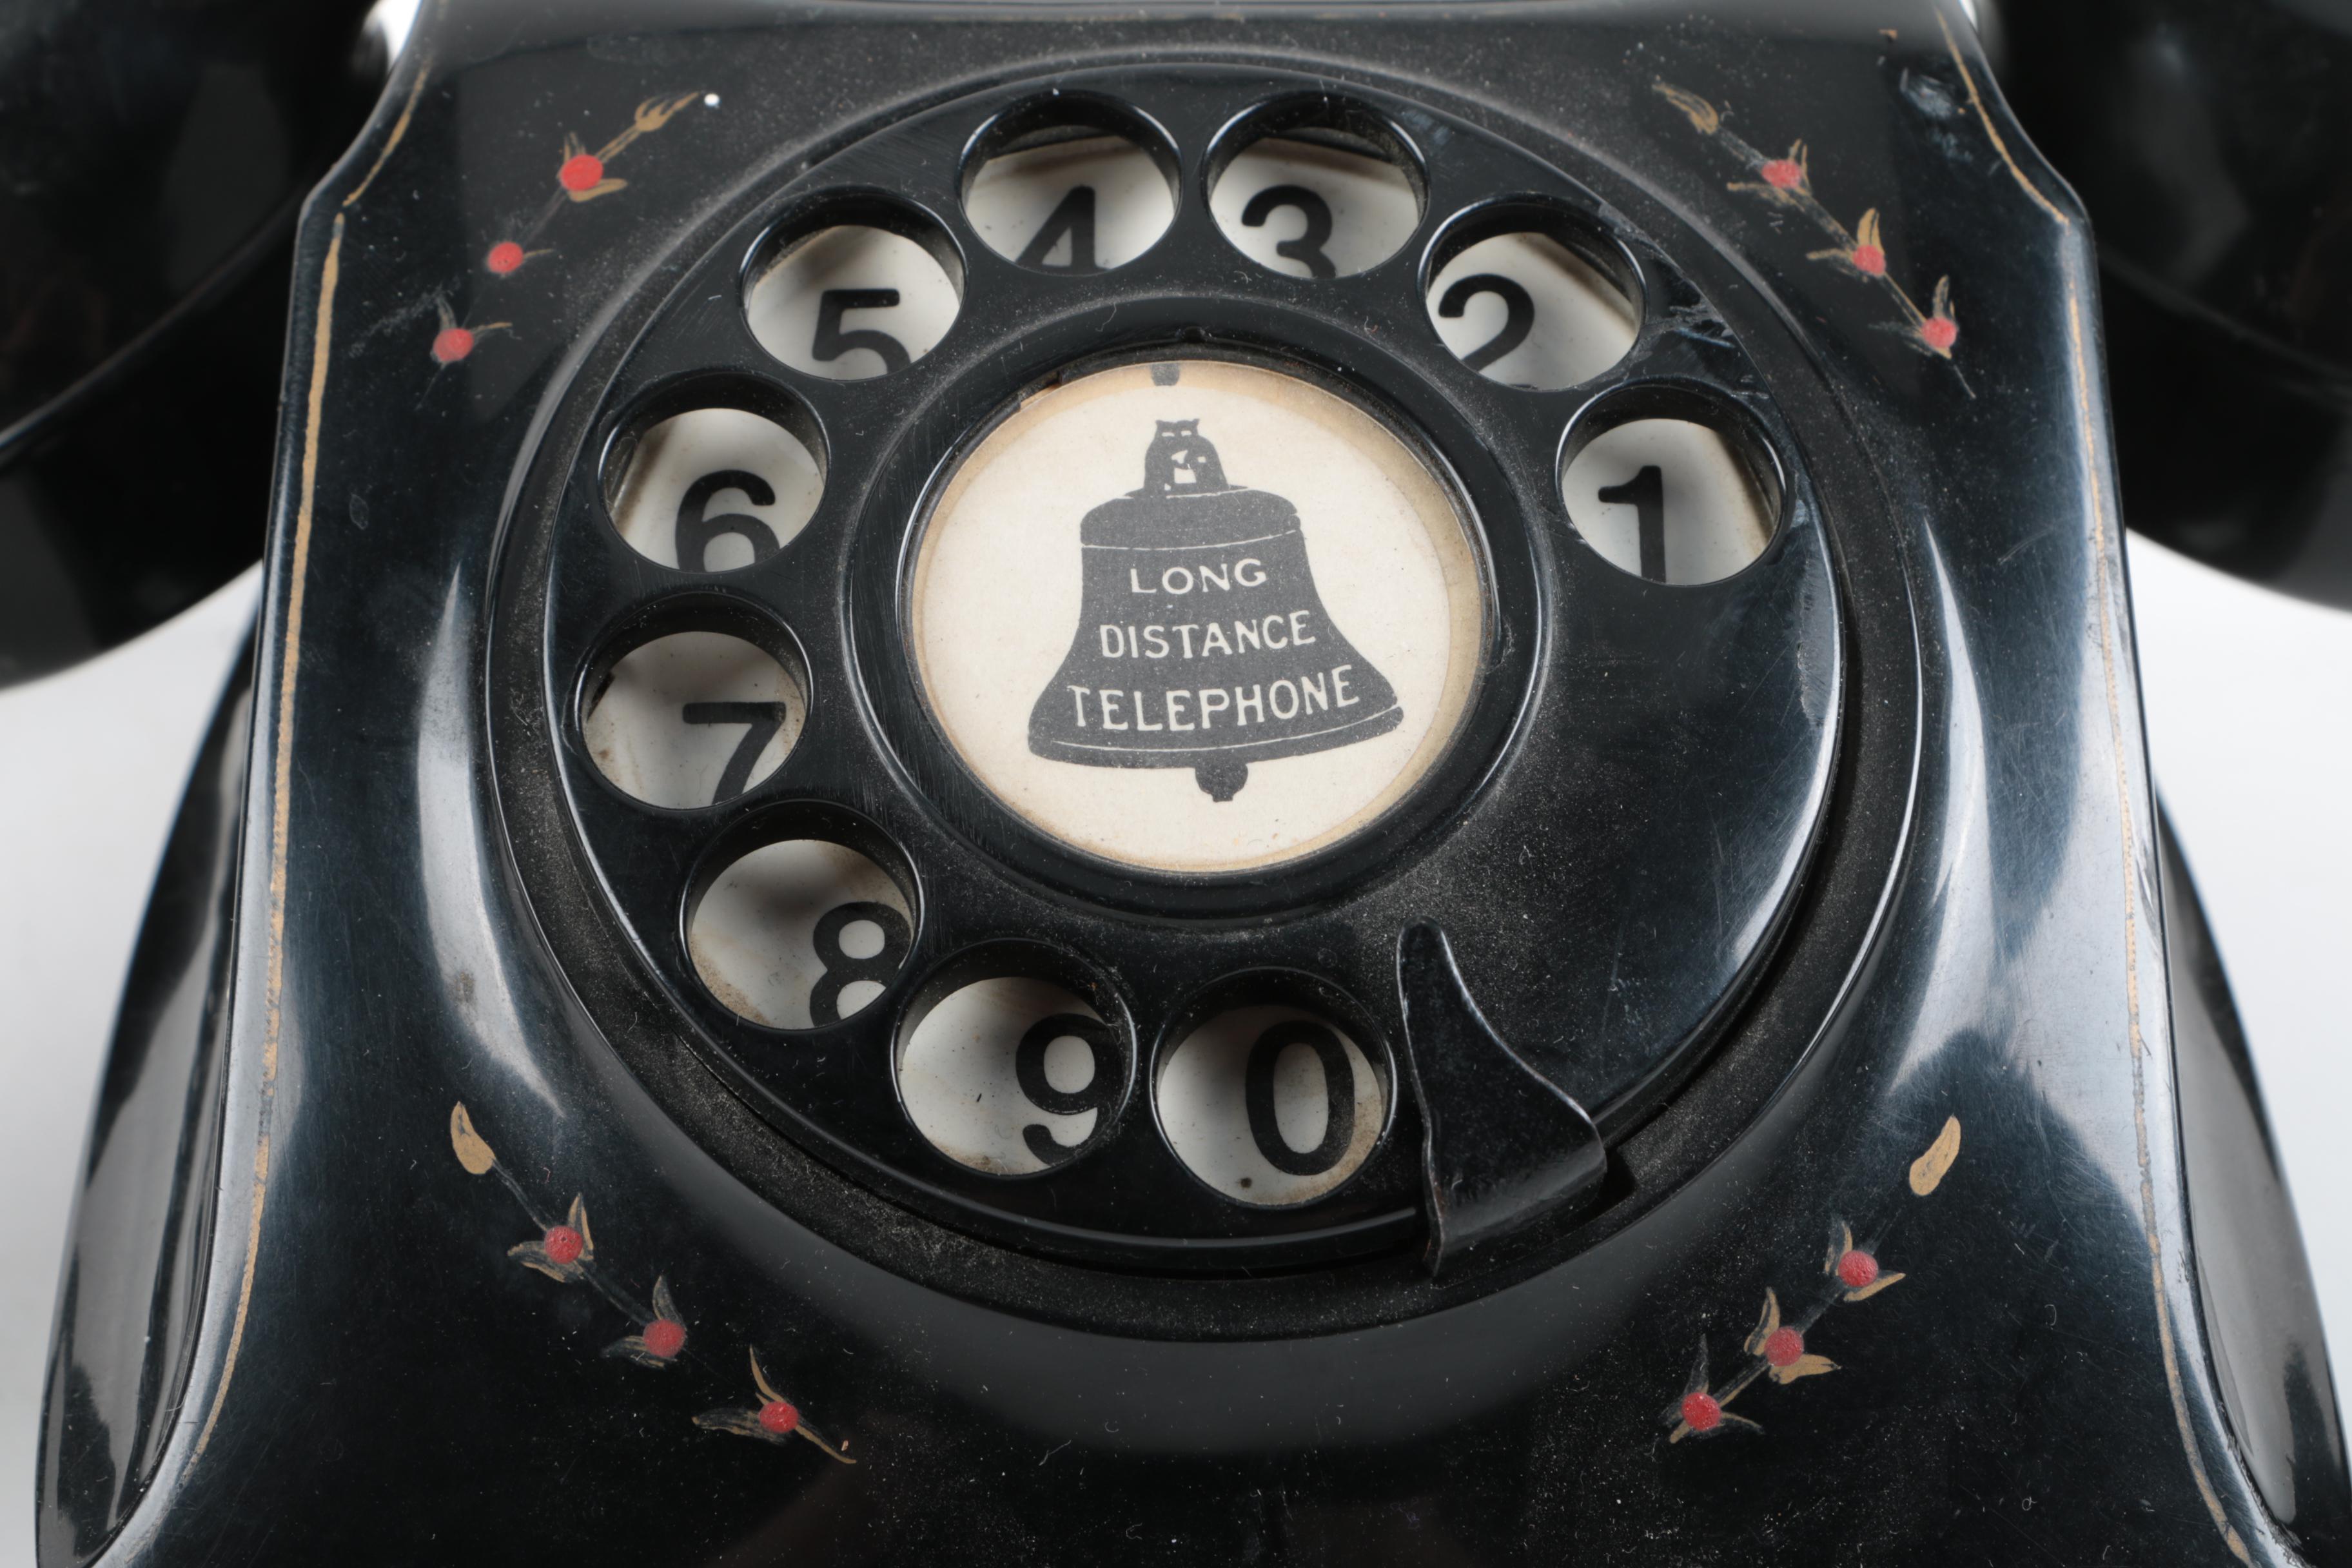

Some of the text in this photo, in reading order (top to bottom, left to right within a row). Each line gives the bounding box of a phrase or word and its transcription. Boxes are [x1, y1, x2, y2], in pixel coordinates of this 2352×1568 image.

[1015, 185, 1108, 275] 4
[1242, 184, 1337, 278] 3
[812, 288, 911, 375] 5
[1438, 274, 1534, 387] 2
[675, 469, 779, 572] 6
[1598, 466, 1667, 583] 1
[1130, 558, 1267, 594] LONG
[1099, 611, 1316, 659] DISTANCE
[1067, 665, 1360, 731] TELEPHONE
[682, 701, 786, 805] 7
[810, 901, 912, 1026] 8
[1016, 1013, 1125, 1166] 9
[1246, 1019, 1355, 1176] 0
